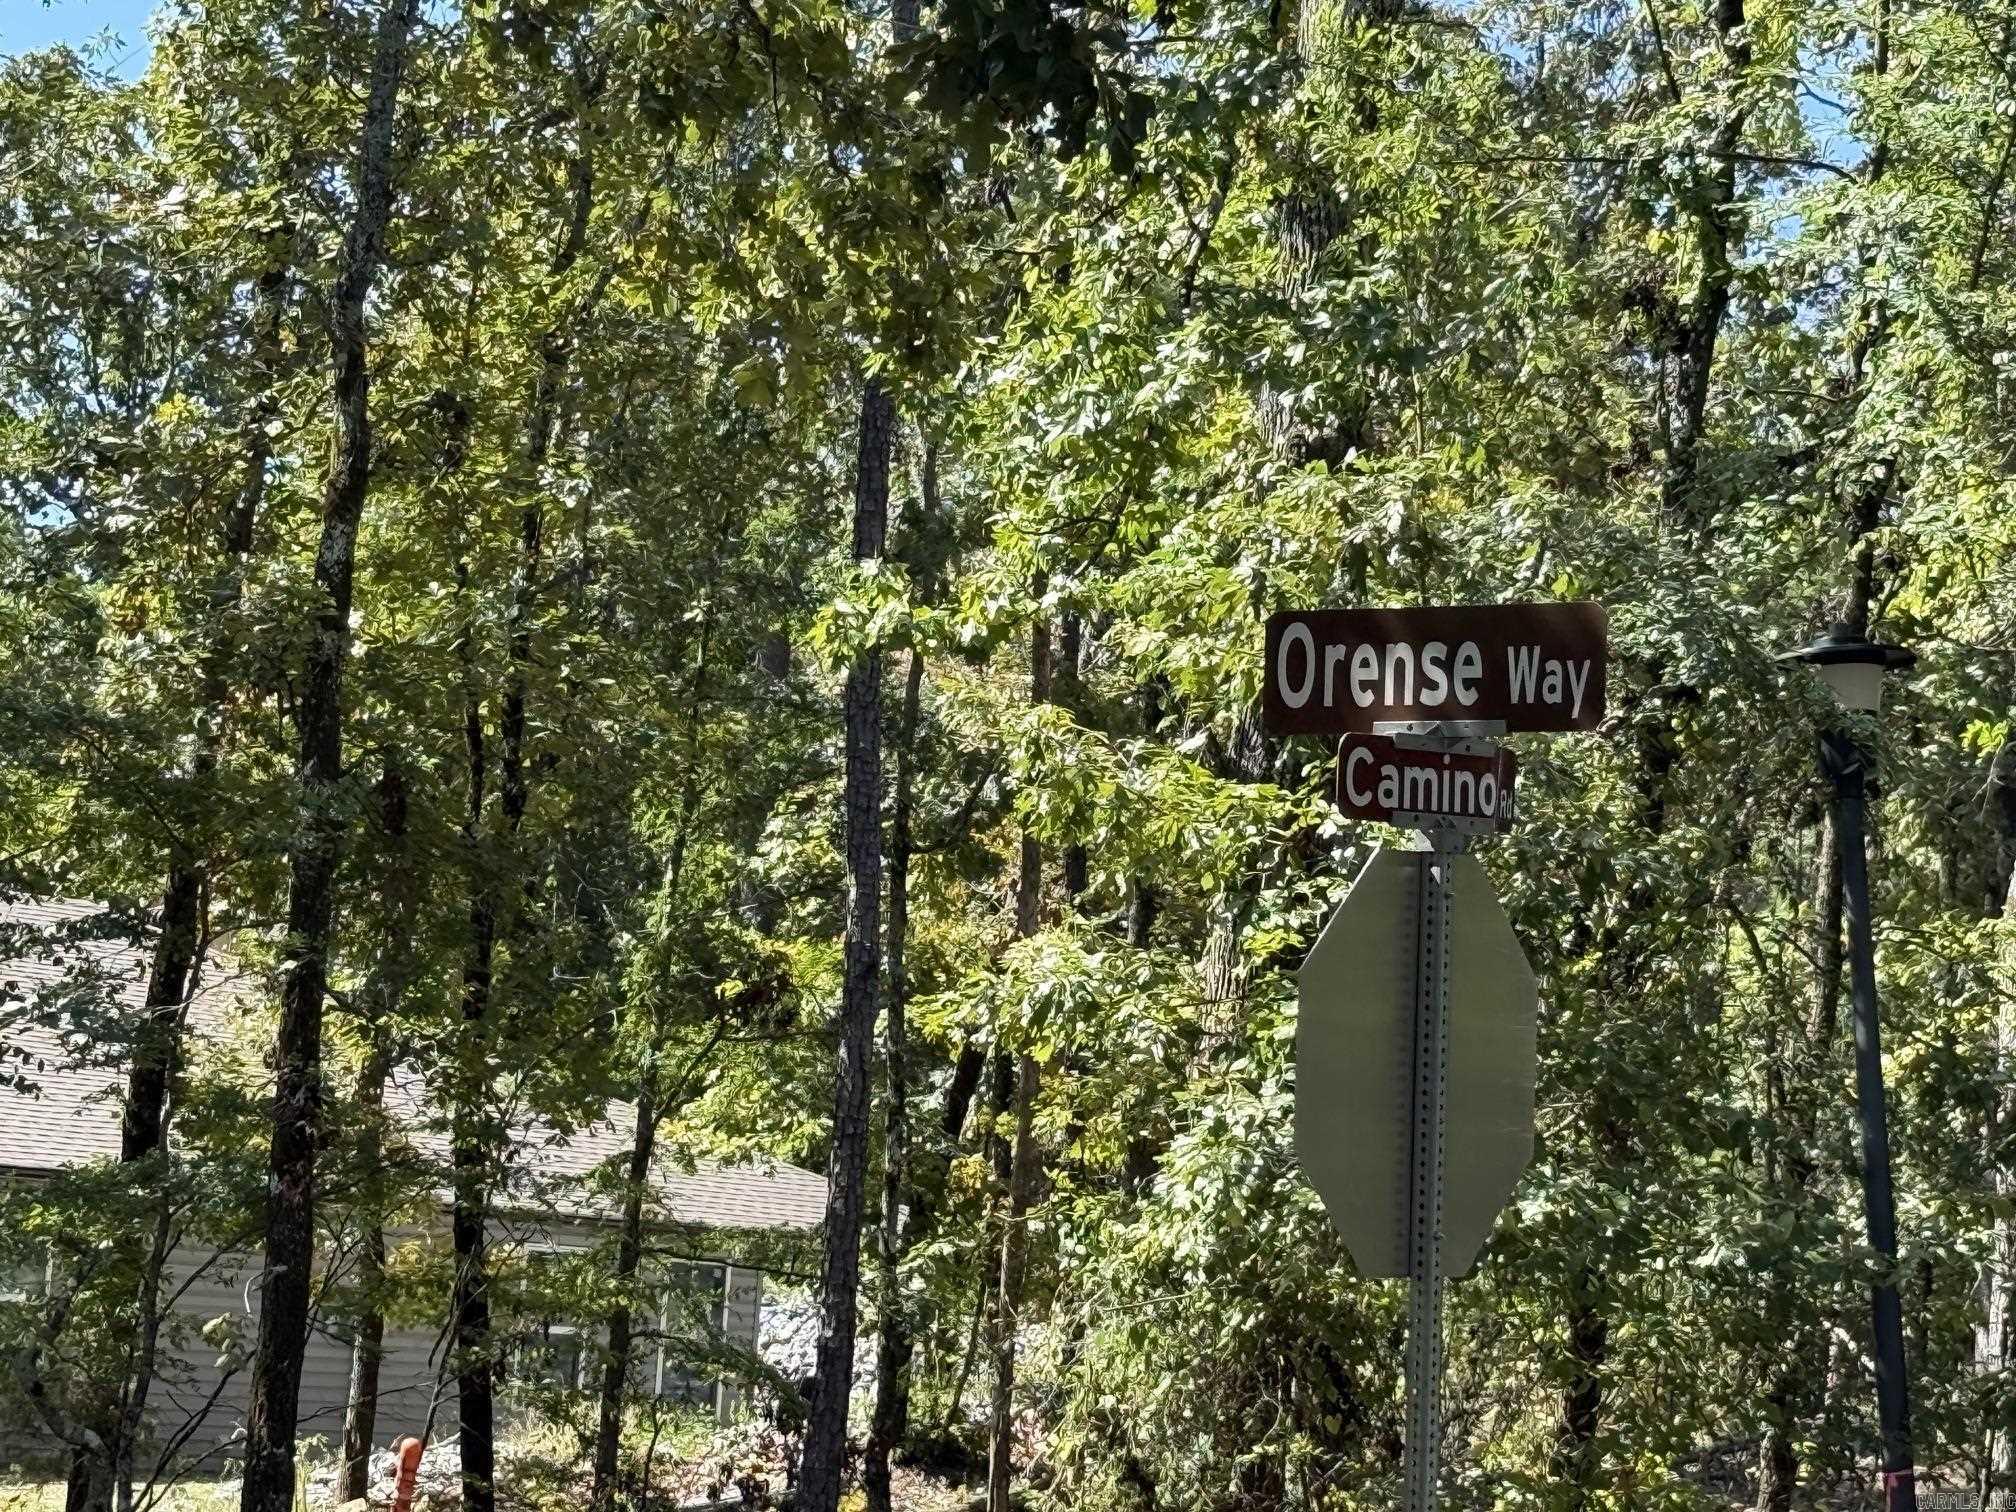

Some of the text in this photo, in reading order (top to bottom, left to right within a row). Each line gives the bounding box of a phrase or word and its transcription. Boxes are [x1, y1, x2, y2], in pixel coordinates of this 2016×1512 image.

[1277, 622, 1591, 719] Orense Way
[1346, 747, 1513, 819] Camino Rd
